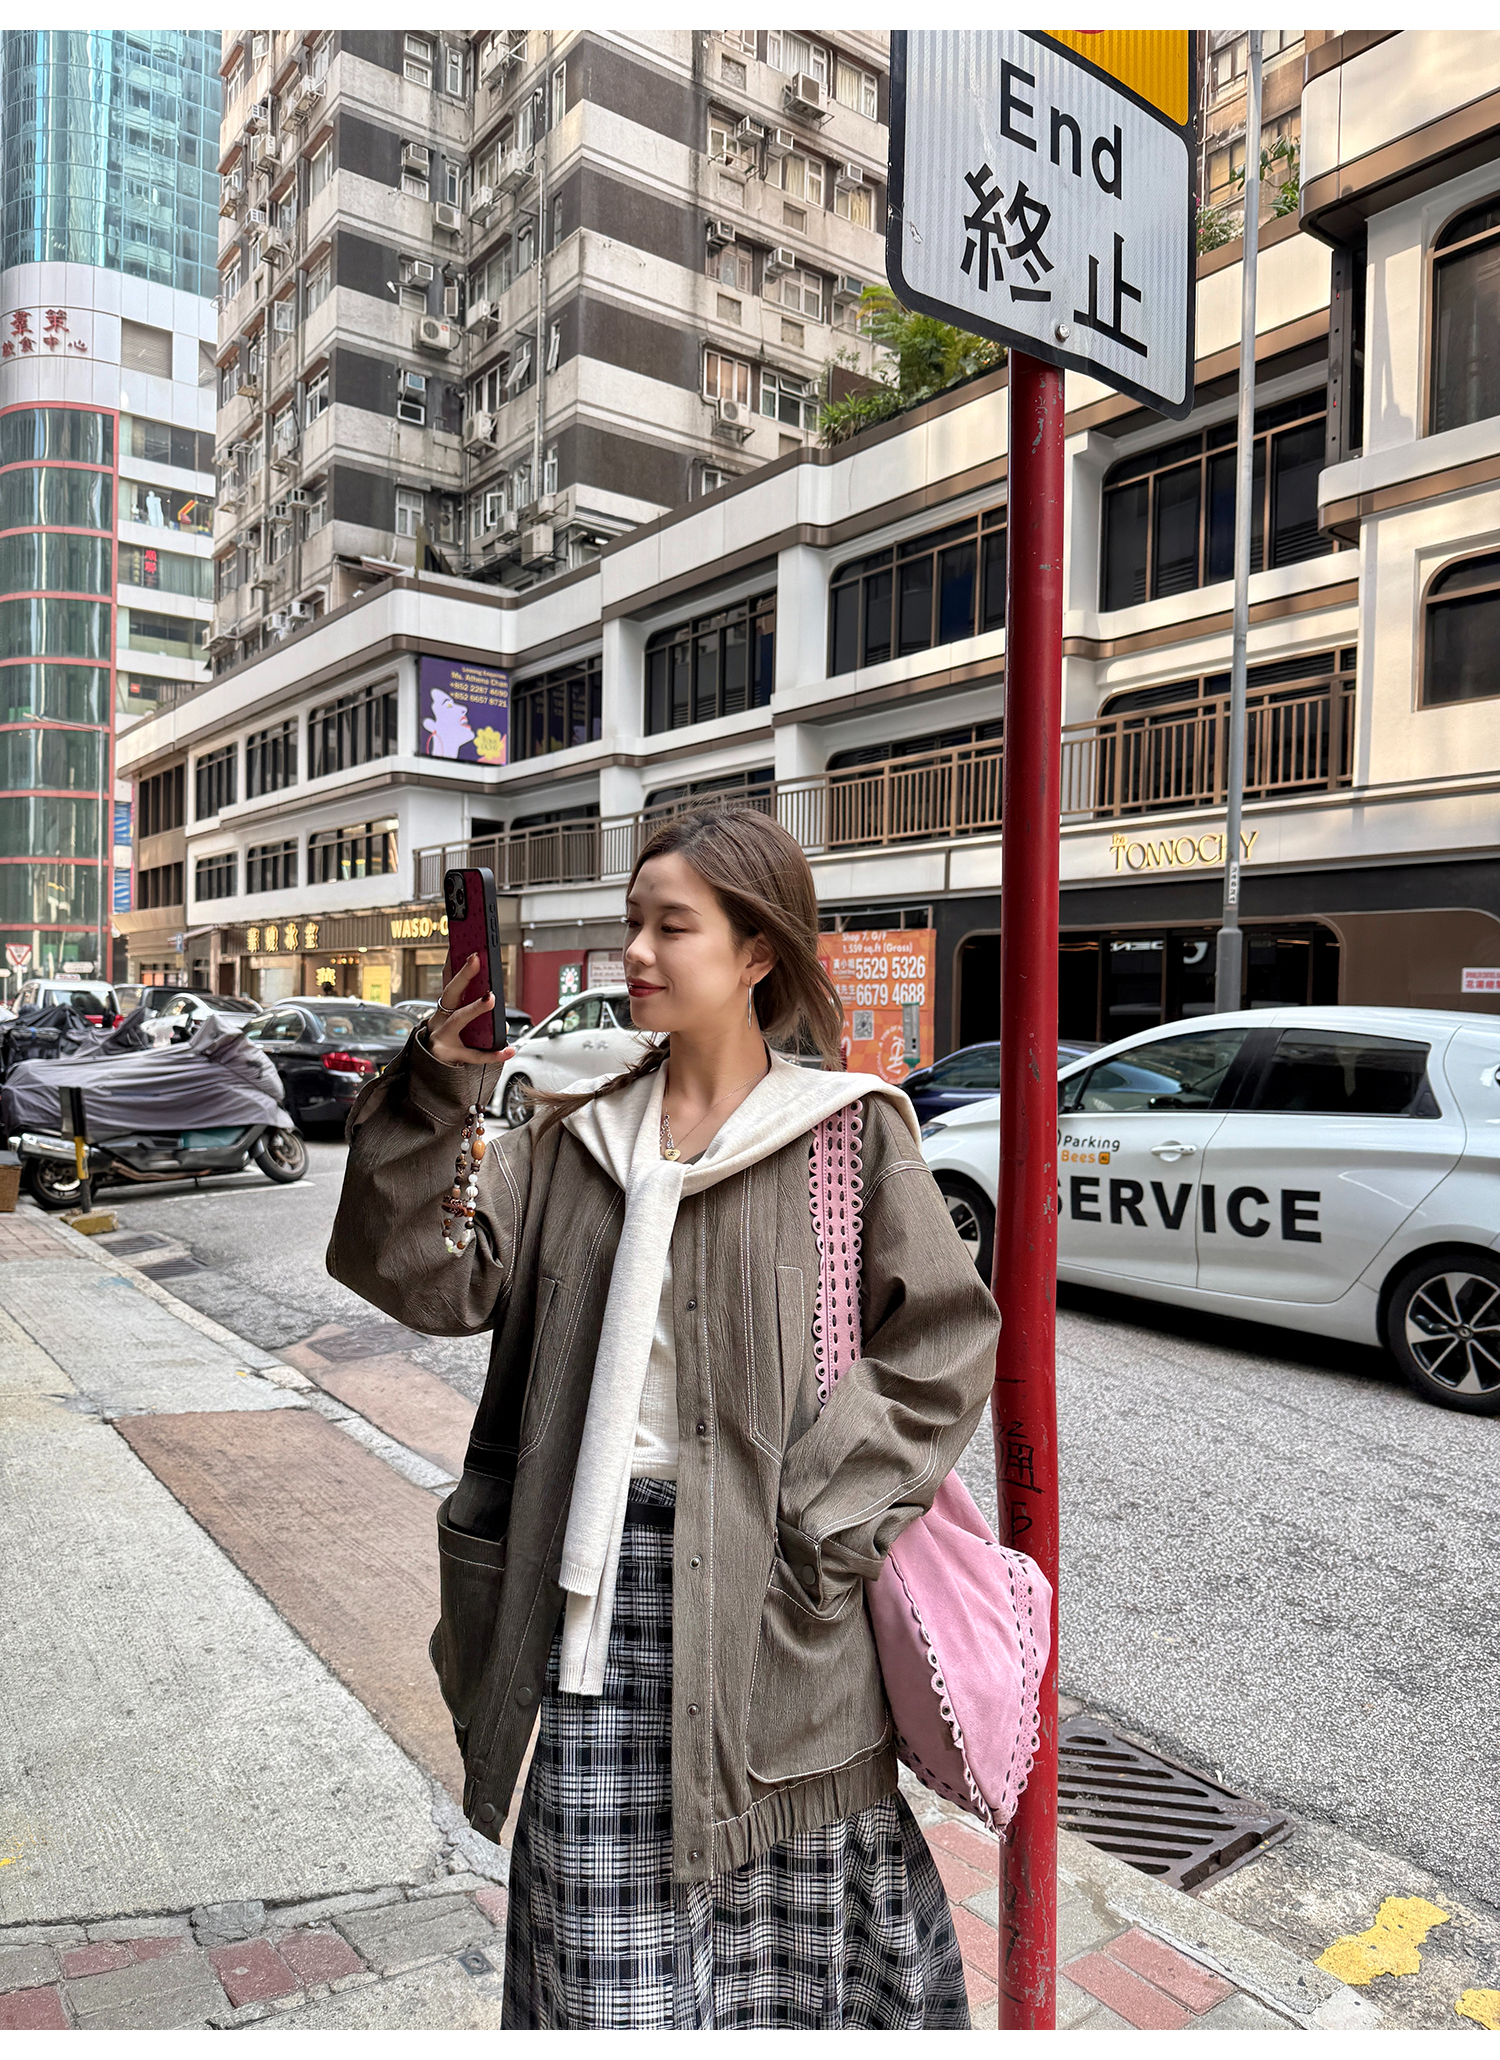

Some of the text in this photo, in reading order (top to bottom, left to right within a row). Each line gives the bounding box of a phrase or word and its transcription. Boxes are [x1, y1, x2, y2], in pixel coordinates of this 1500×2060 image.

[1000, 57, 1122, 200] End
[960, 163, 1148, 358] 終止
[842, 932, 861, 943] Shop
[883, 942, 913, 954] (Gross)
[855, 955, 926, 980] 5529 5326
[856, 983, 925, 1006] 6679 4688
[1063, 1135, 1121, 1152] Parking
[1061, 1149, 1096, 1163] Bees
[1057, 1175, 1322, 1244] ERVICE
